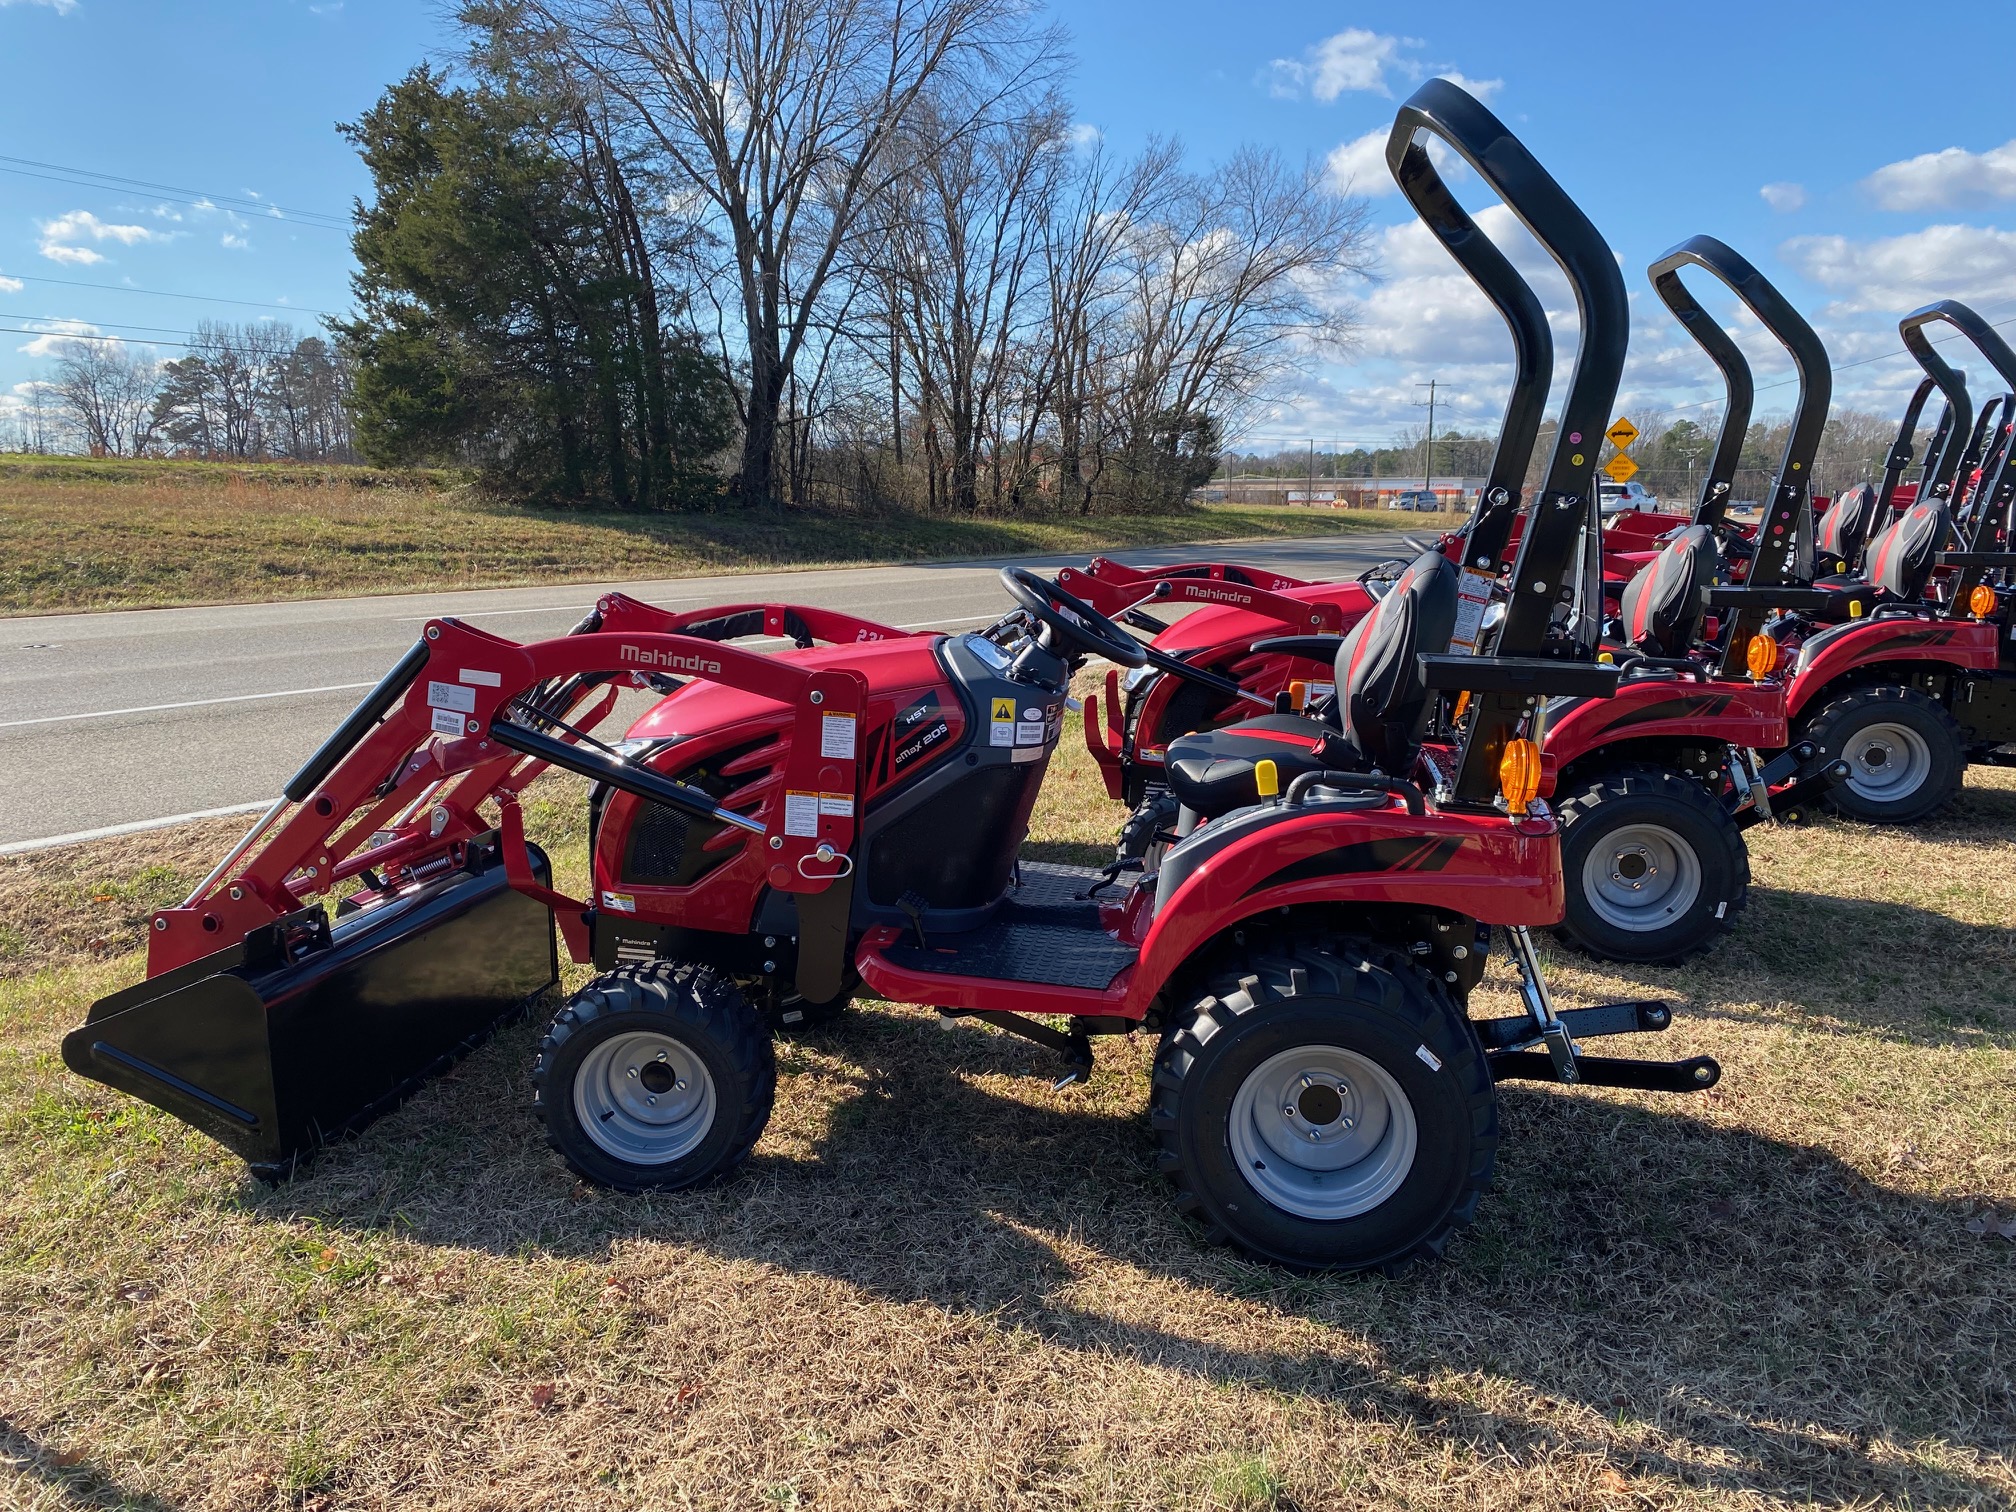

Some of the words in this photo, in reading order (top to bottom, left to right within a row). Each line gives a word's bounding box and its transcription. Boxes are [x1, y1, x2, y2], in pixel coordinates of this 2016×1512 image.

[1185, 585, 1252, 604] Mahindra
[620, 644, 721, 674] Mahindra
[905, 704, 927, 724] HST
[922, 723, 948, 746] 20S
[622, 938, 651, 946] Mahindra
